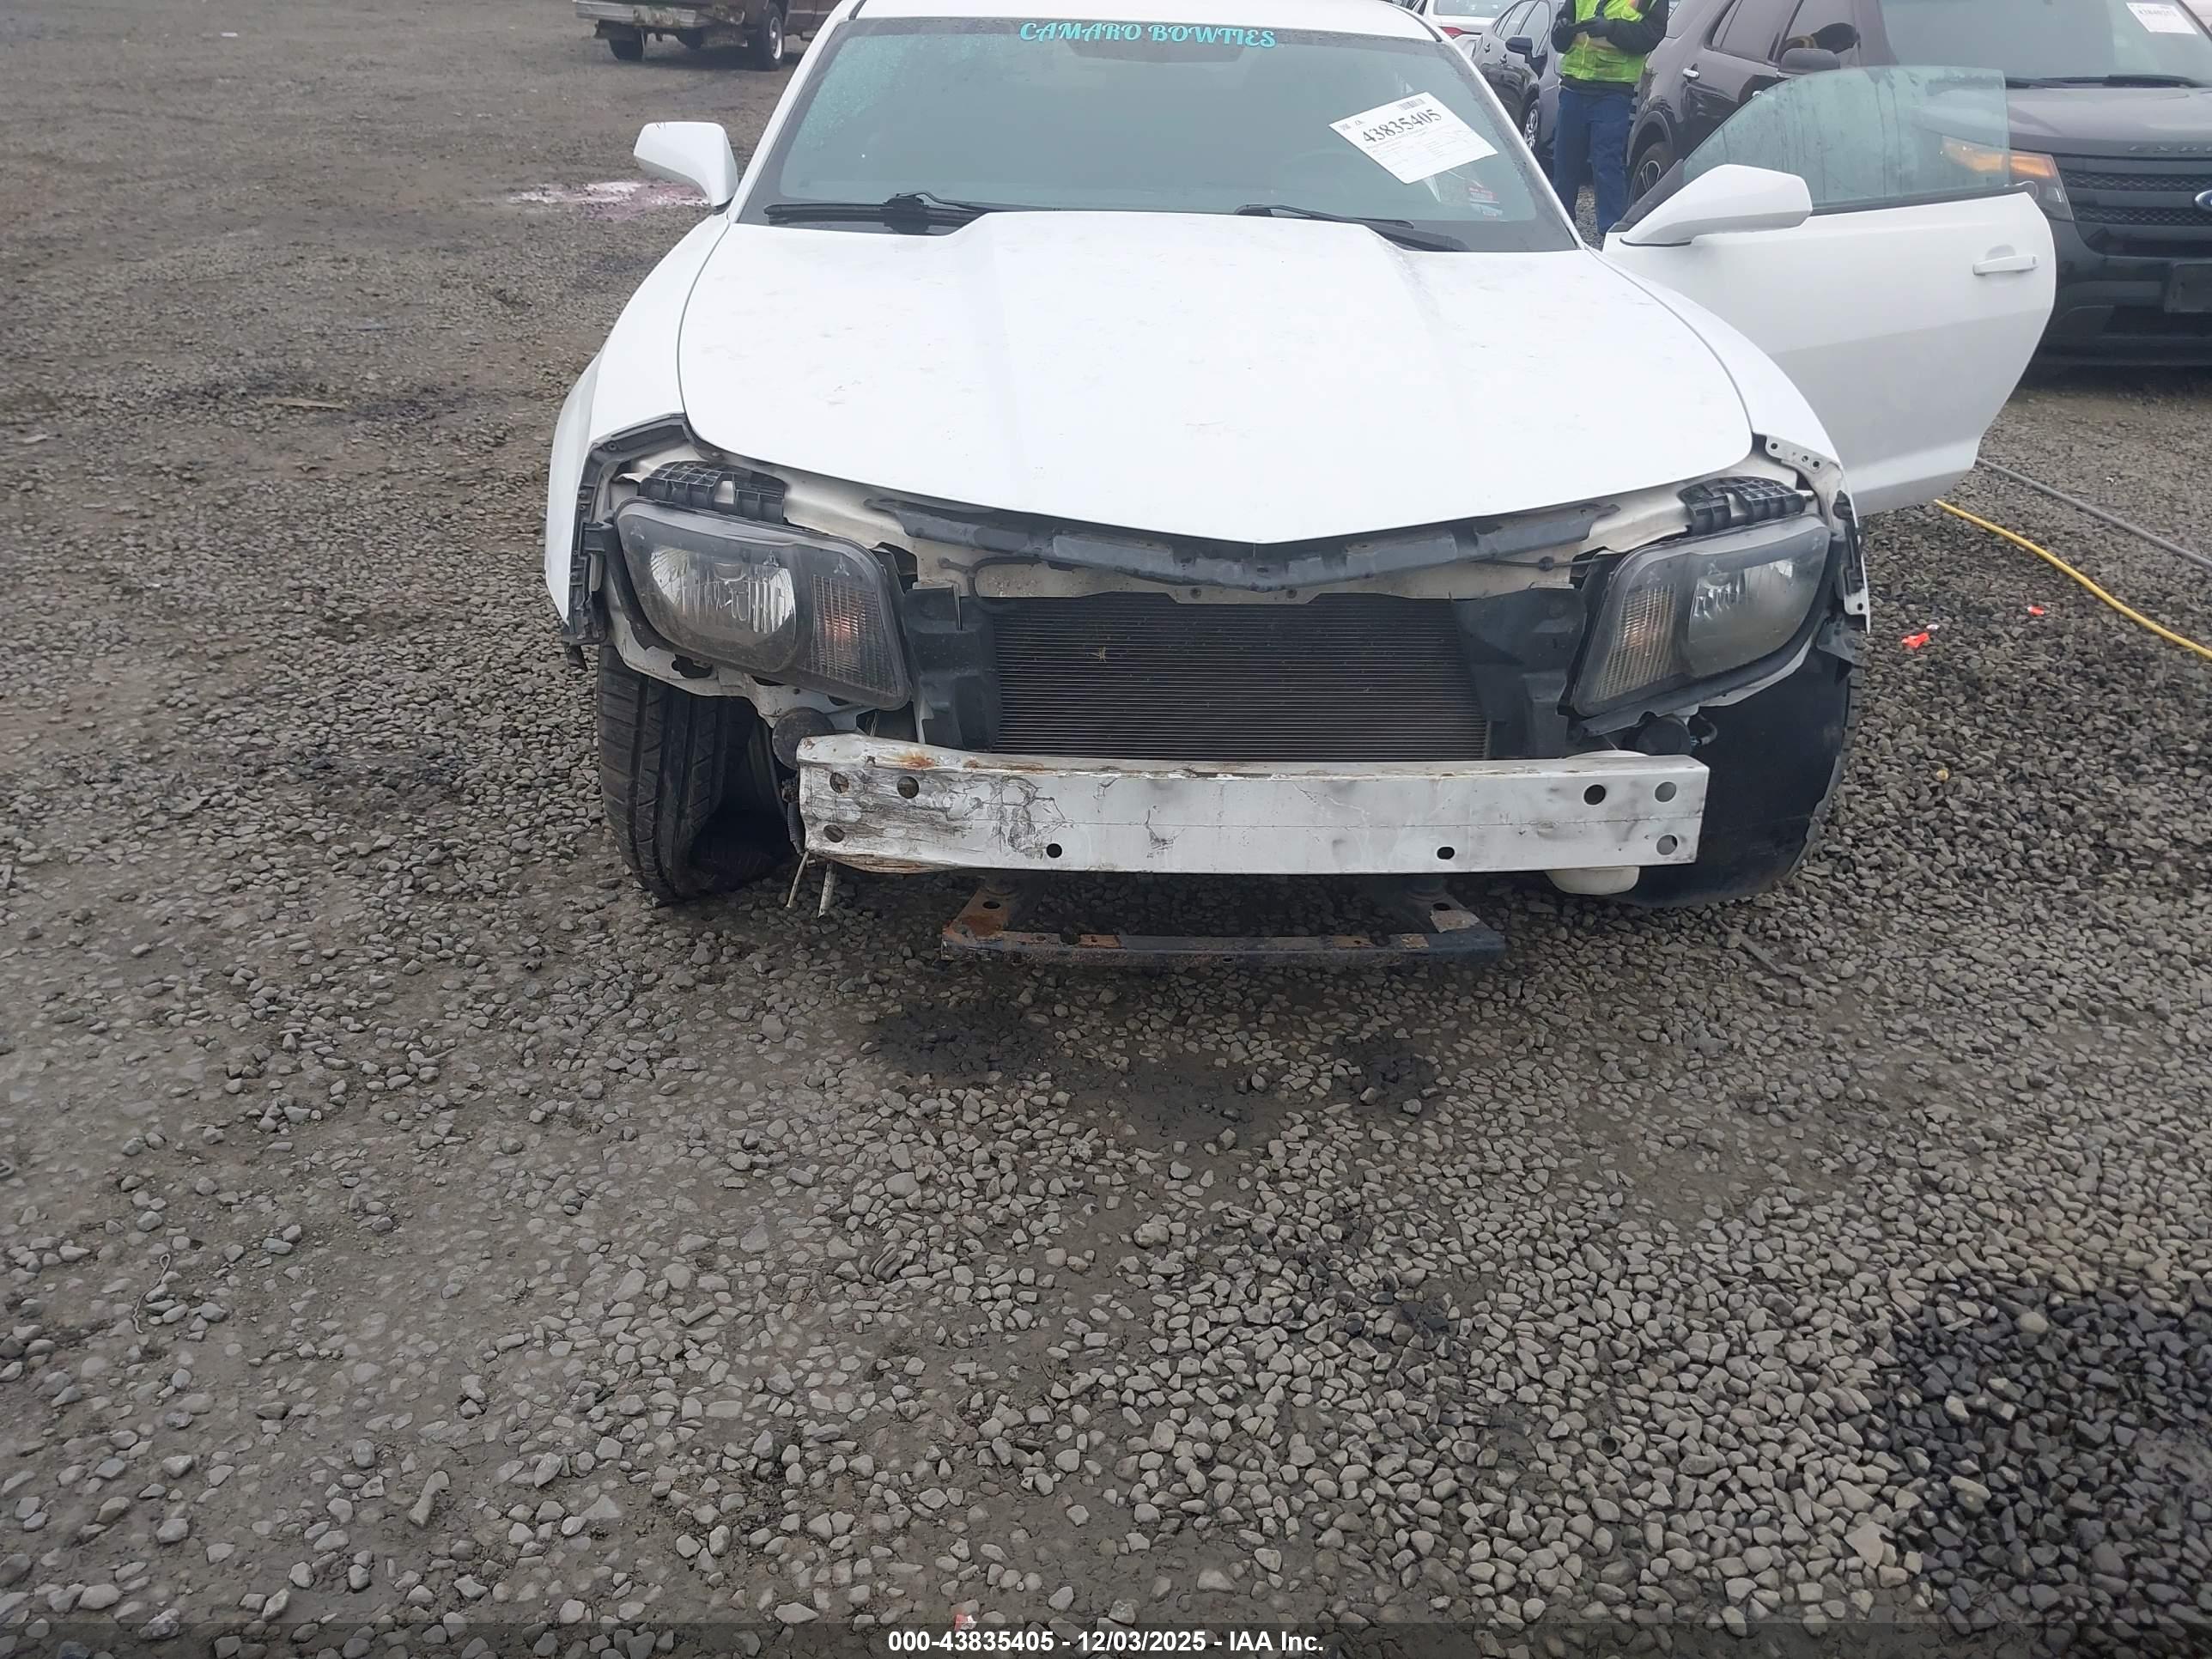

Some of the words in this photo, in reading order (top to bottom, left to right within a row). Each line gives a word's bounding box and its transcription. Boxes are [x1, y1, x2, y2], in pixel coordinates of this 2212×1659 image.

[1019, 22, 1142, 41] CAMARO
[1148, 23, 1277, 48] BOWTIES
[1363, 109, 1442, 142] 43835405
